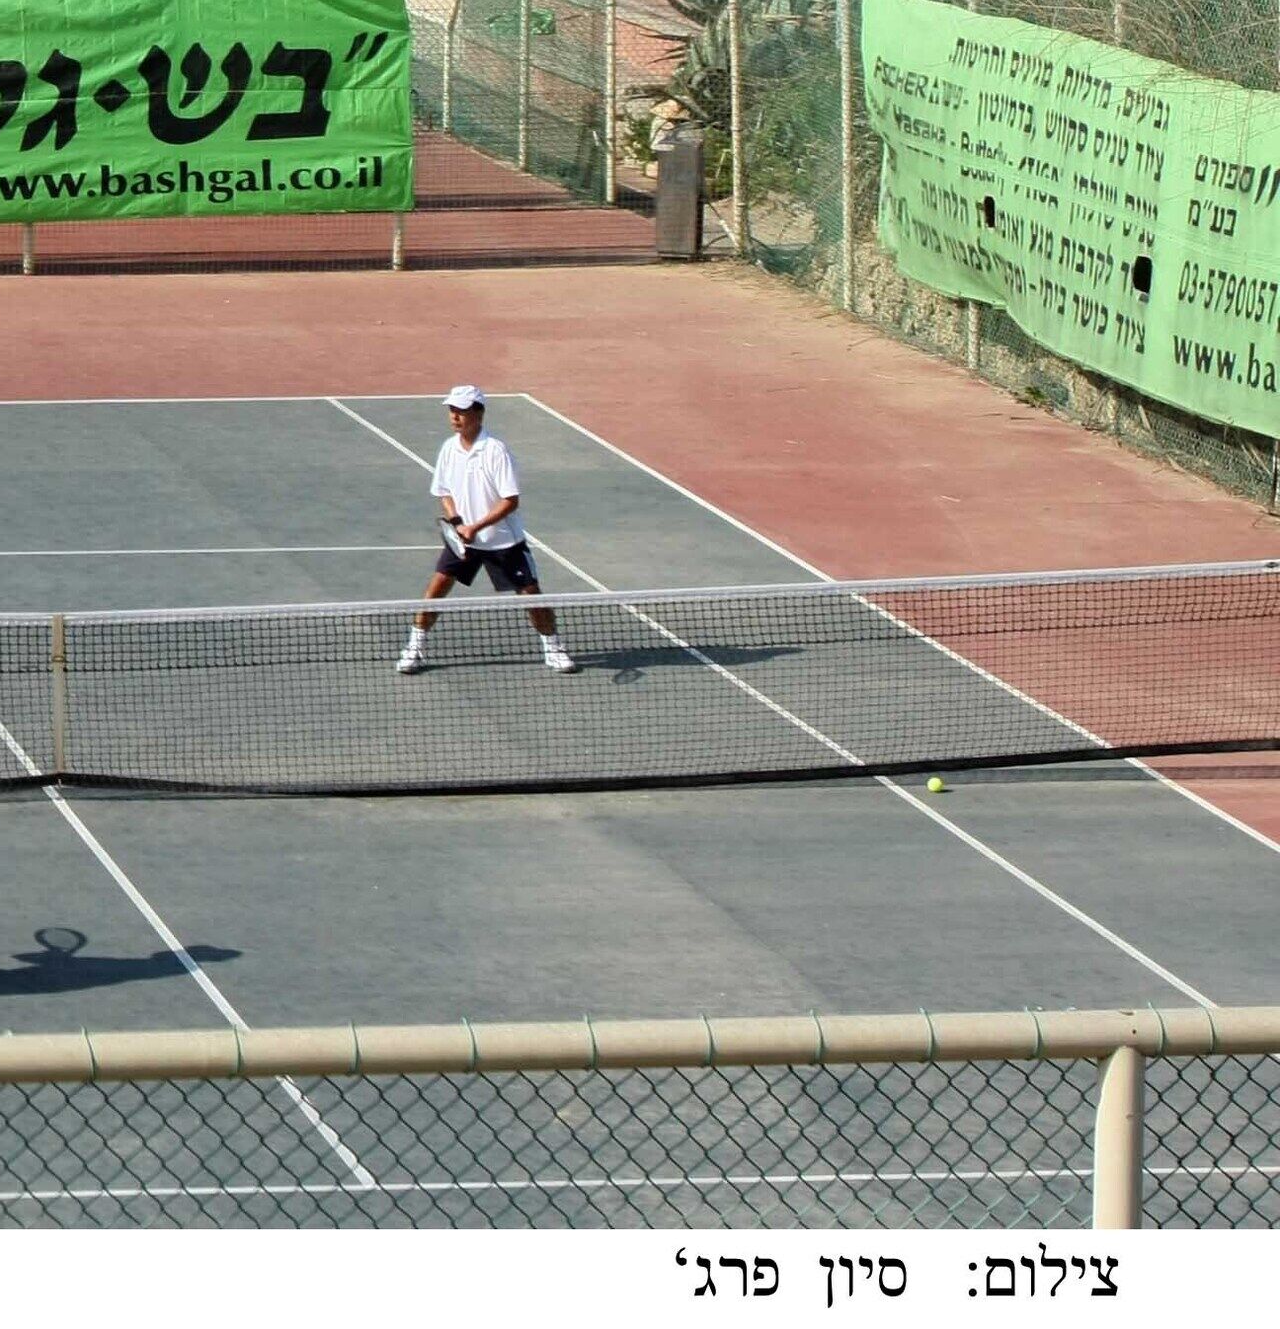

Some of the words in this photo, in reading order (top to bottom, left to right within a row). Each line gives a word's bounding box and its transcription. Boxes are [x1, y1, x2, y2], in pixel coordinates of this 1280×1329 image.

[1194, 154, 1256, 194] ספורט
[1072, 291, 1109, 335] כושר
[1177, 259, 1279, 325] 03-5790057
[1115, 311, 1146, 354] ציוד
